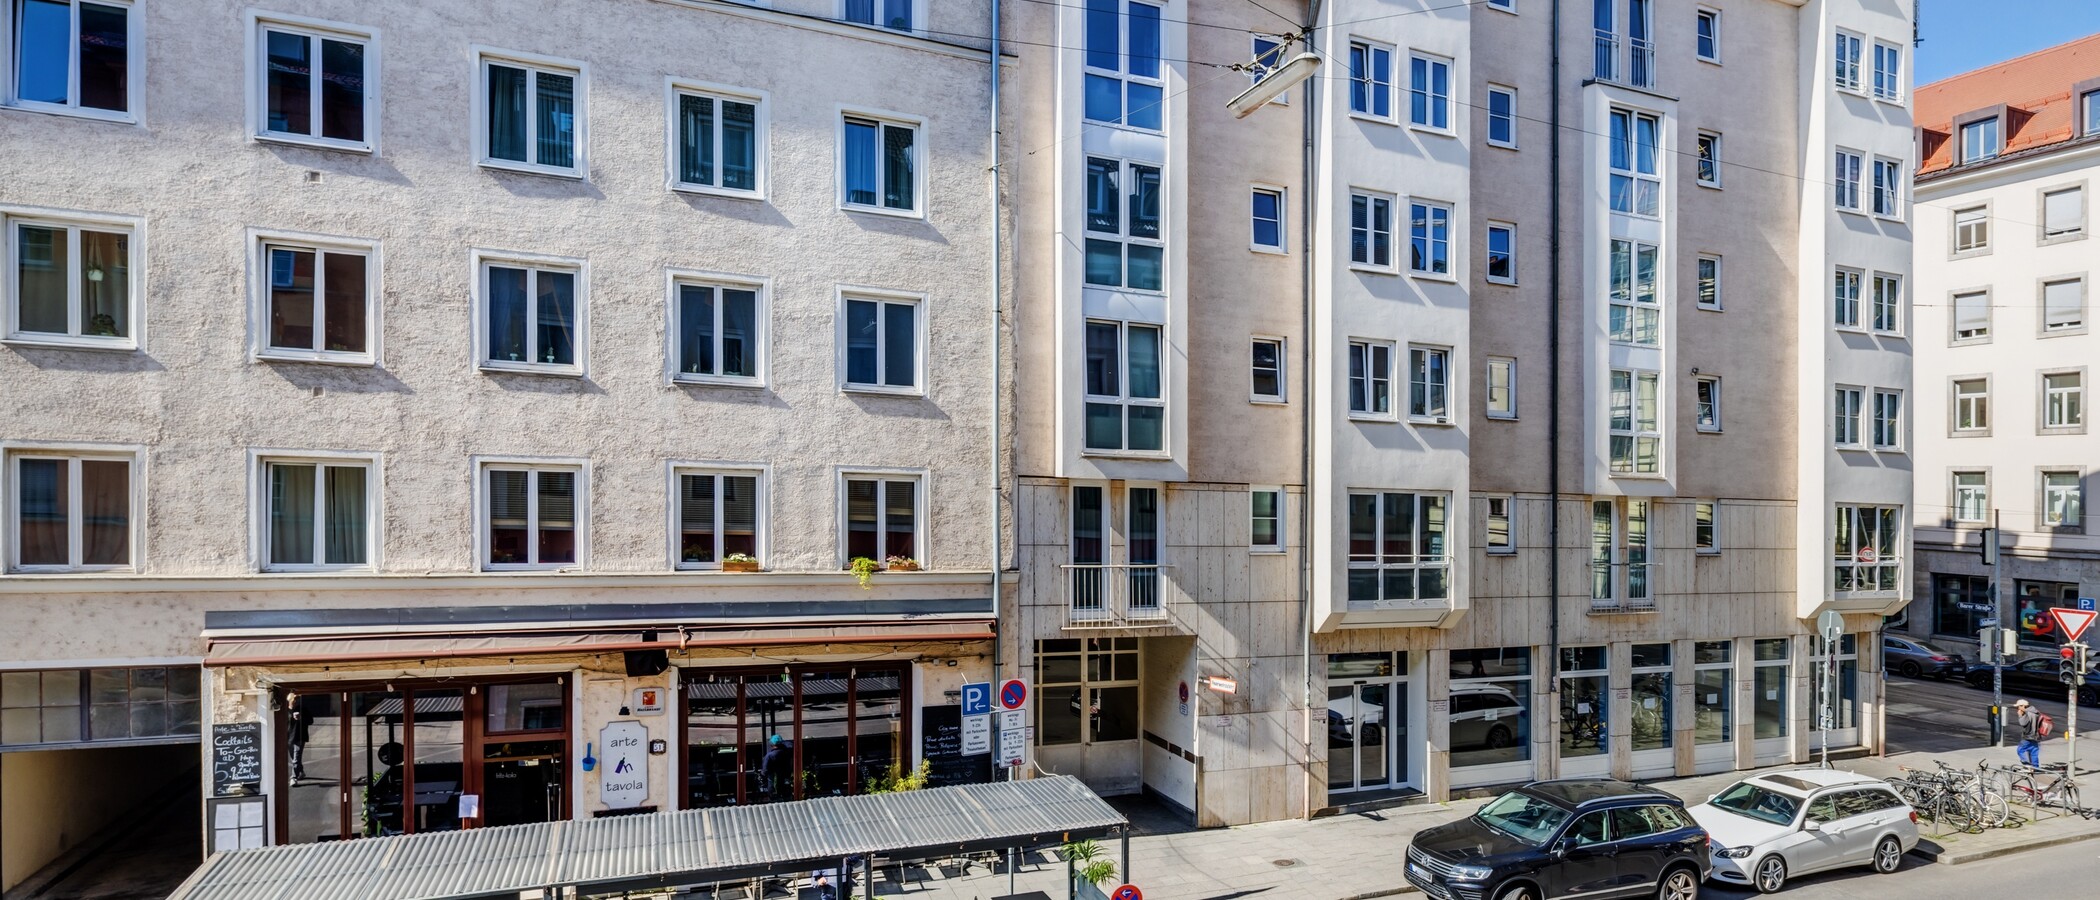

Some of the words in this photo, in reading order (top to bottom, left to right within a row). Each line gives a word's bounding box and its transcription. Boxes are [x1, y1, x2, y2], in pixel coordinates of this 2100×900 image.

[966, 688, 982, 712] P
[214, 735, 253, 746] Cocktails
[611, 737, 637, 748] arte
[605, 780, 643, 792] tavola
